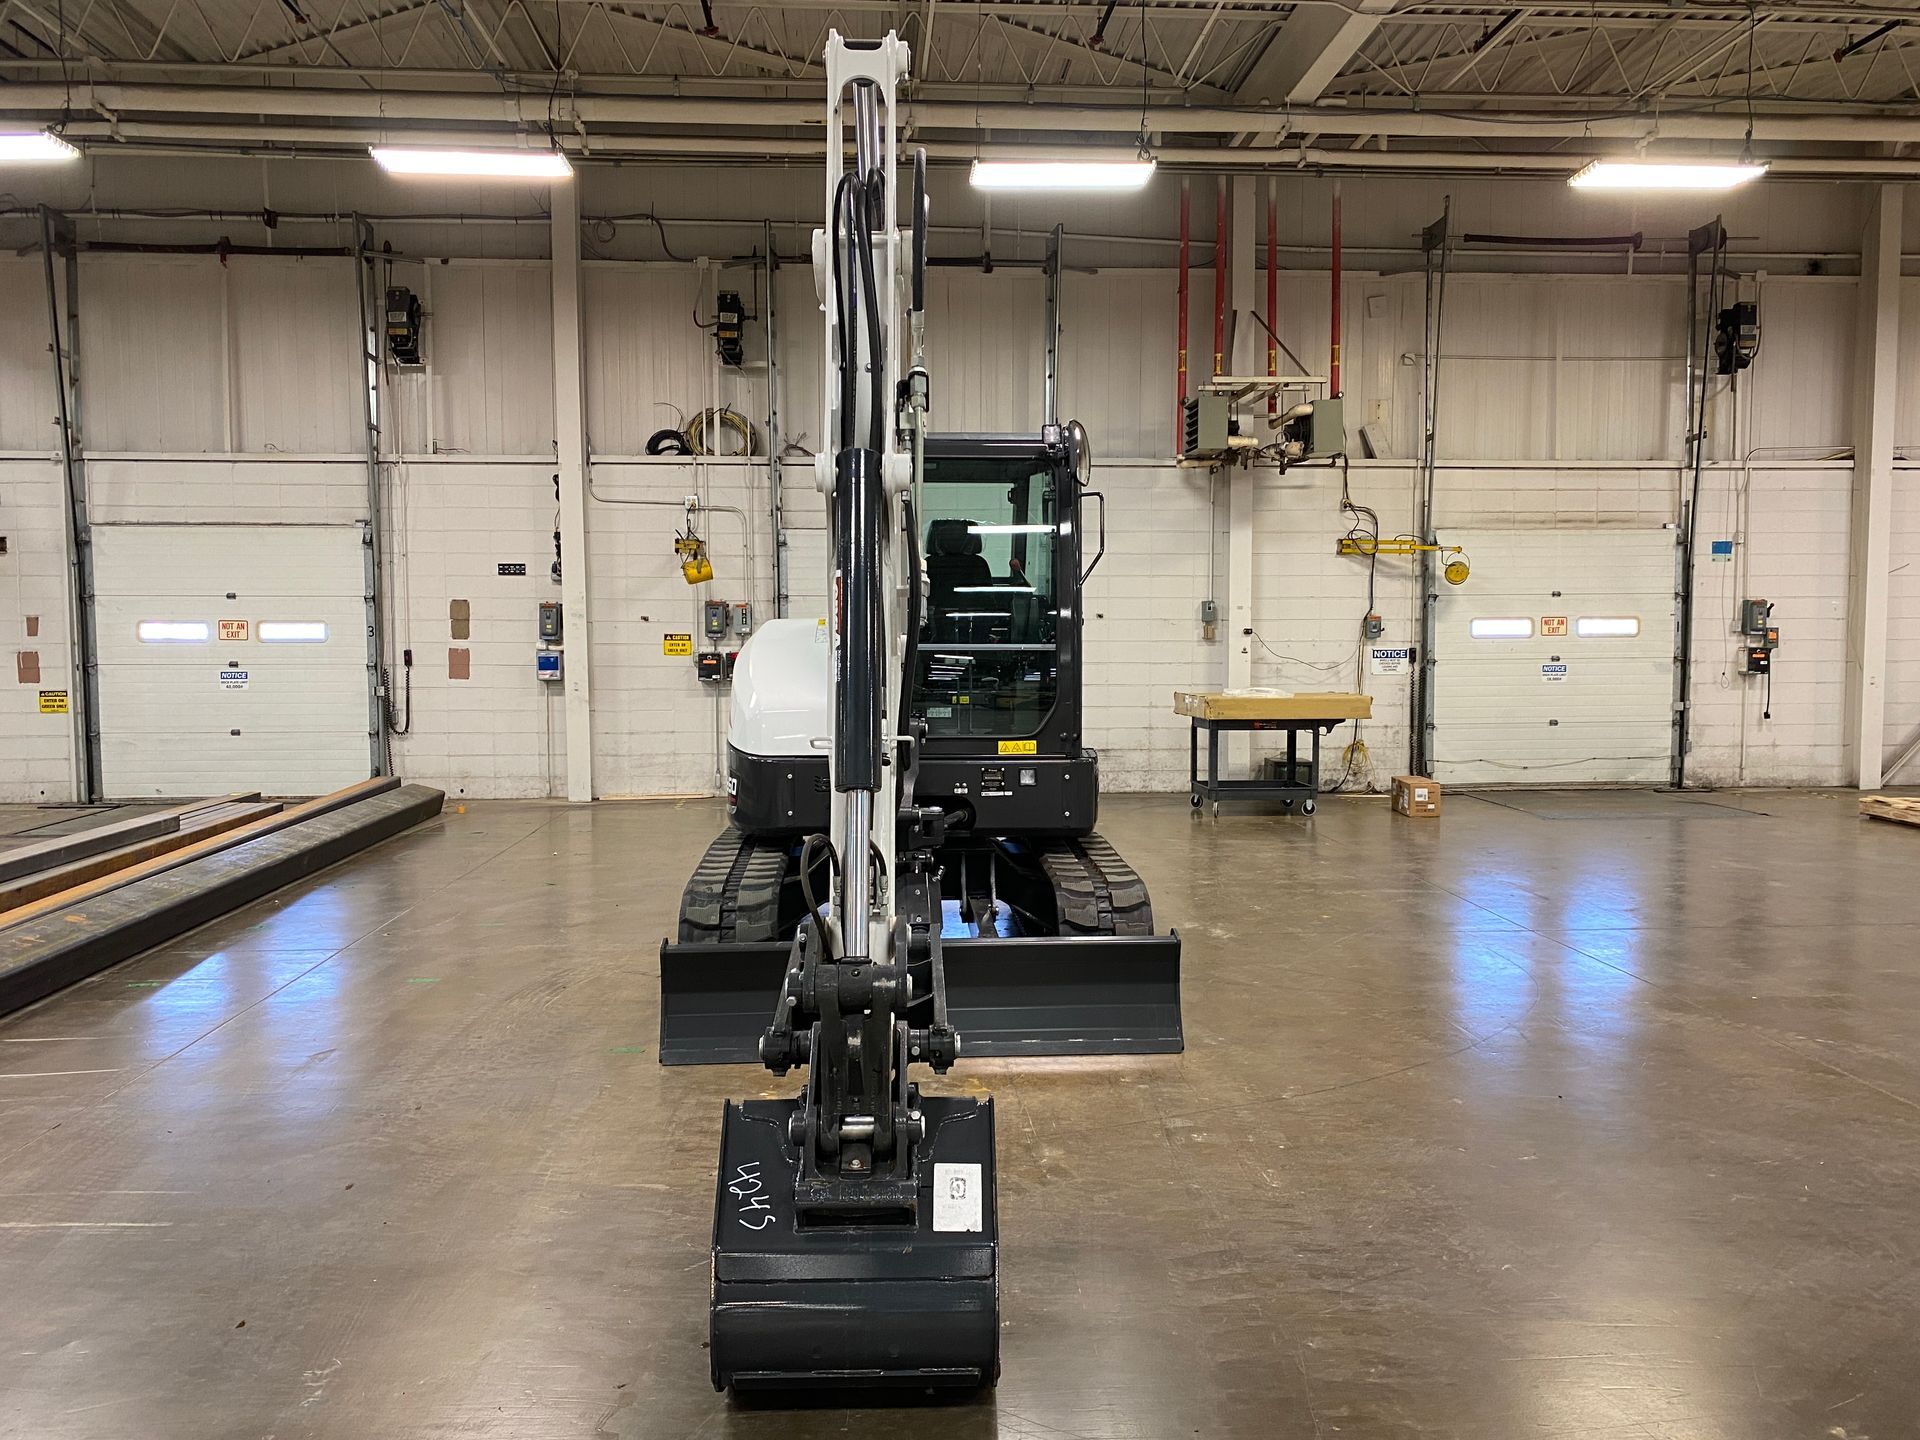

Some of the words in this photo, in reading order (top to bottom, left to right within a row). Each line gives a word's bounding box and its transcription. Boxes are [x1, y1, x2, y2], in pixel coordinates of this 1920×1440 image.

[368, 625, 374, 637] 3
[1374, 650, 1406, 658] NOTICE
[728, 1161, 776, 1230] 4245
